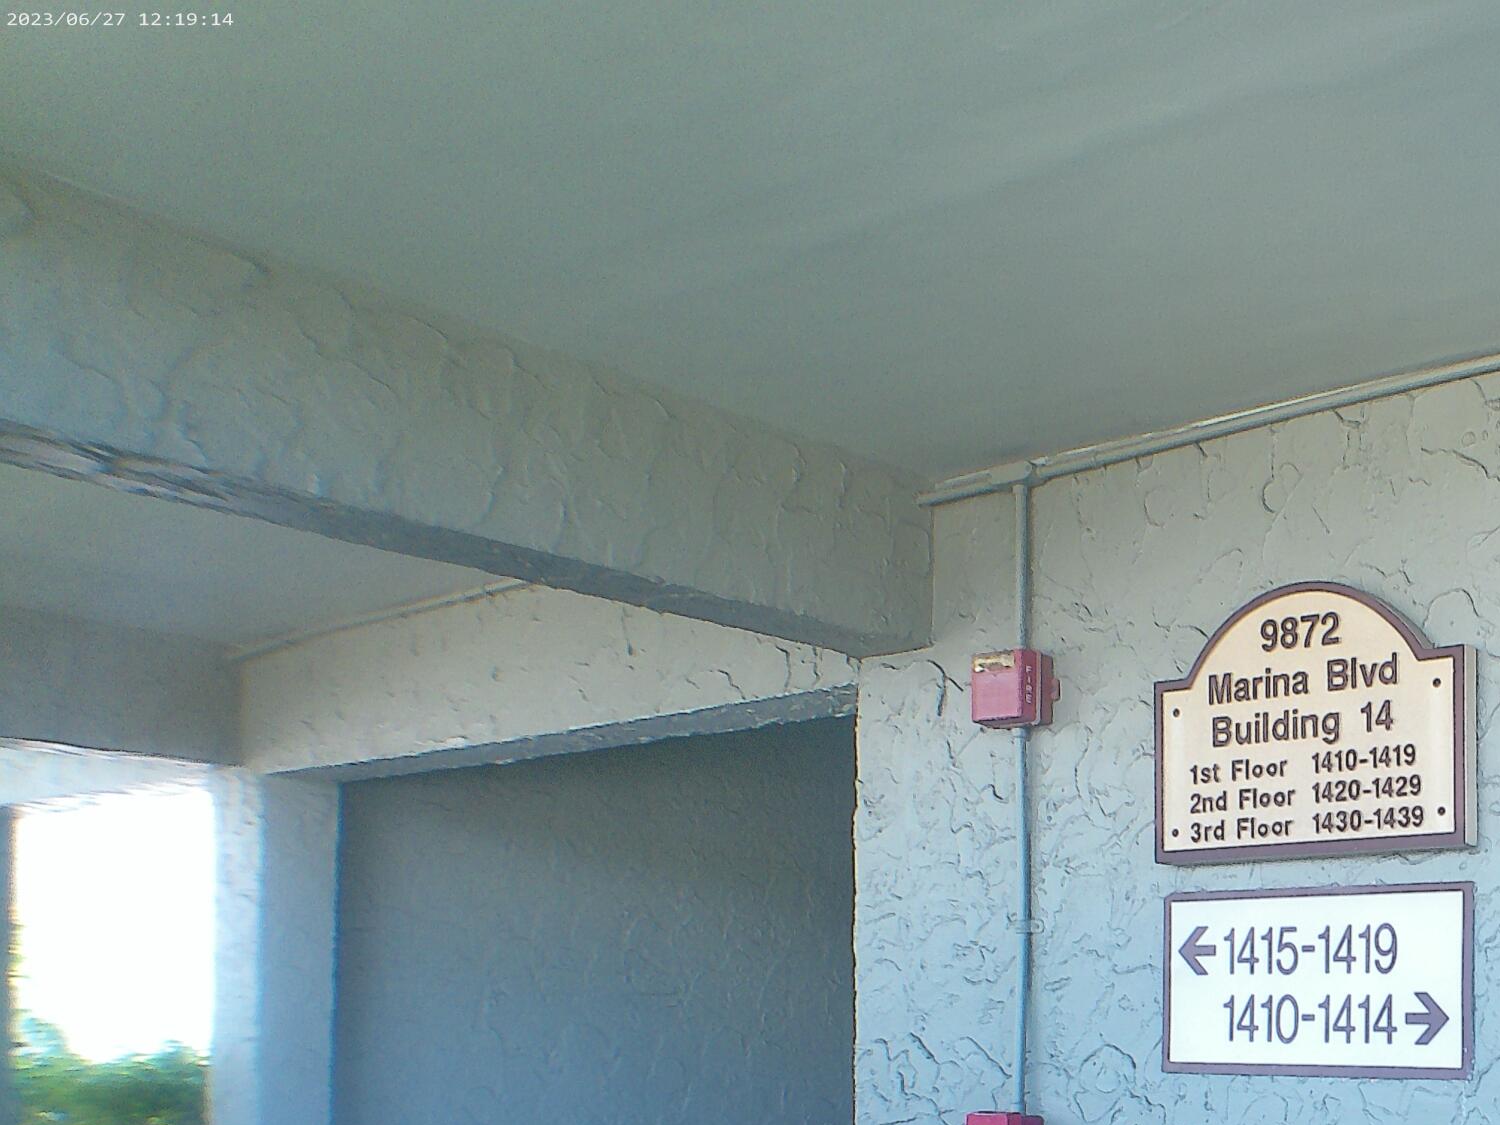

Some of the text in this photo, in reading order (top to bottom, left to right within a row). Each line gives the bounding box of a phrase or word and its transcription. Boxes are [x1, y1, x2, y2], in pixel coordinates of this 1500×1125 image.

[1260, 612, 1340, 652] 9872
[1208, 652, 1398, 705] Marina Blvd
[1212, 700, 1393, 747] Building 14
[1190, 743, 1416, 784] 1st Floor 1410-1419
[1190, 774, 1422, 813] 2nd Floor 1420-1429
[1190, 806, 1424, 842] 3rd Floor 1430-1439
[1223, 923, 1398, 975] 1415-1419
[1223, 993, 1398, 1044] 1410-1414
